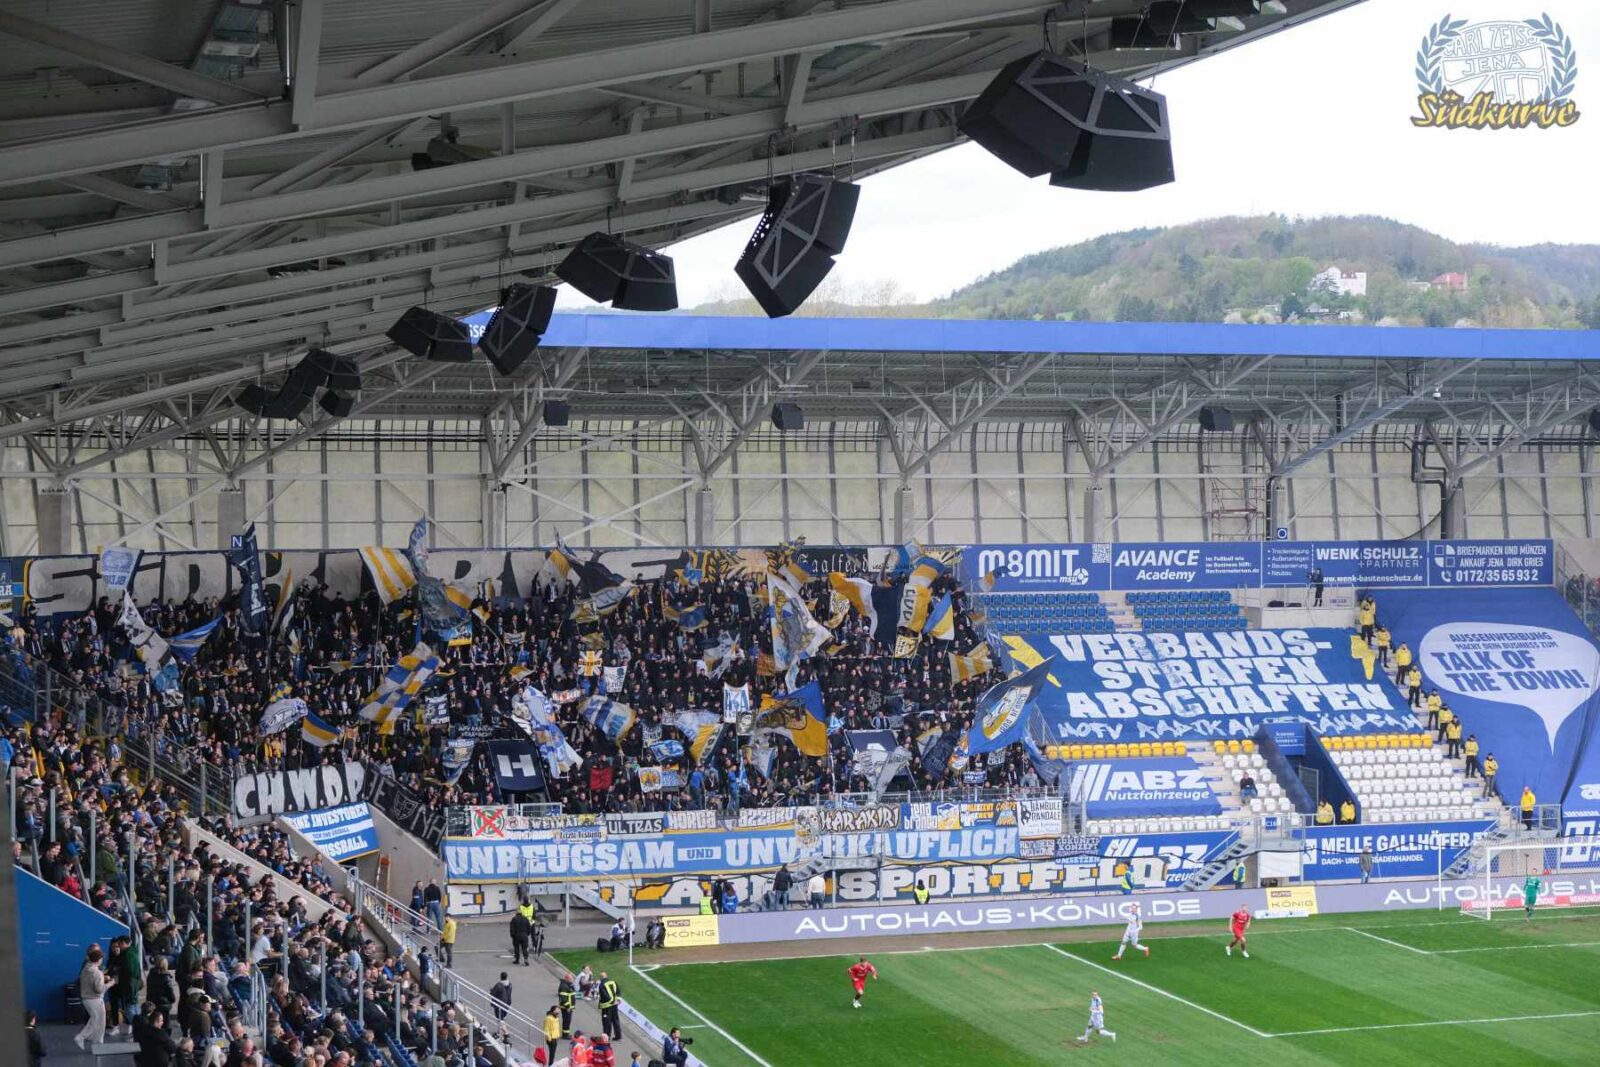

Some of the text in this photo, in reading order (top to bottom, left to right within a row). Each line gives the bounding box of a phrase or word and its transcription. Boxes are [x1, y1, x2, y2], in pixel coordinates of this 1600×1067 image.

[231, 535, 243, 547] N
[1316, 548, 1360, 561] WENK
[1456, 543, 1547, 556] BRIEFMARKEN UND MÜNZEN
[1114, 549, 1201, 567] AVANCE
[1459, 556, 1544, 568] ANKAUF JENA DIRK GRIES
[1135, 569, 1196, 583] Academy
[1455, 569, 1500, 582] 0172/35
[1501, 569, 1515, 582] 65
[1449, 631, 1552, 643] AUSSENWERBUNG
[1049, 629, 1333, 662] VERBANDS-
[1455, 641, 1481, 651] MACHT
[1501, 640, 1540, 650] BUSINESS
[1430, 649, 1536, 671] TALK OF
[1093, 657, 1328, 690] STRAFEN
[1445, 669, 1591, 692] THE TOWN!
[1066, 683, 1395, 719] ABSCHAFFEN
[1108, 769, 1208, 790] ABZ
[1104, 790, 1210, 802] Nutzfahrzeuge
[820, 805, 900, 833] HARAKIRI
[607, 818, 663, 835] ULTRAS
[321, 838, 367, 858] USSBALL
[1320, 835, 1373, 855] MELLE
[445, 840, 674, 875] UNBEUGSAM
[686, 847, 714, 860] UND
[1321, 857, 1344, 866] DACH-
[1271, 900, 1314, 908] KÖNIG
[666, 930, 715, 938] KÖNIG
